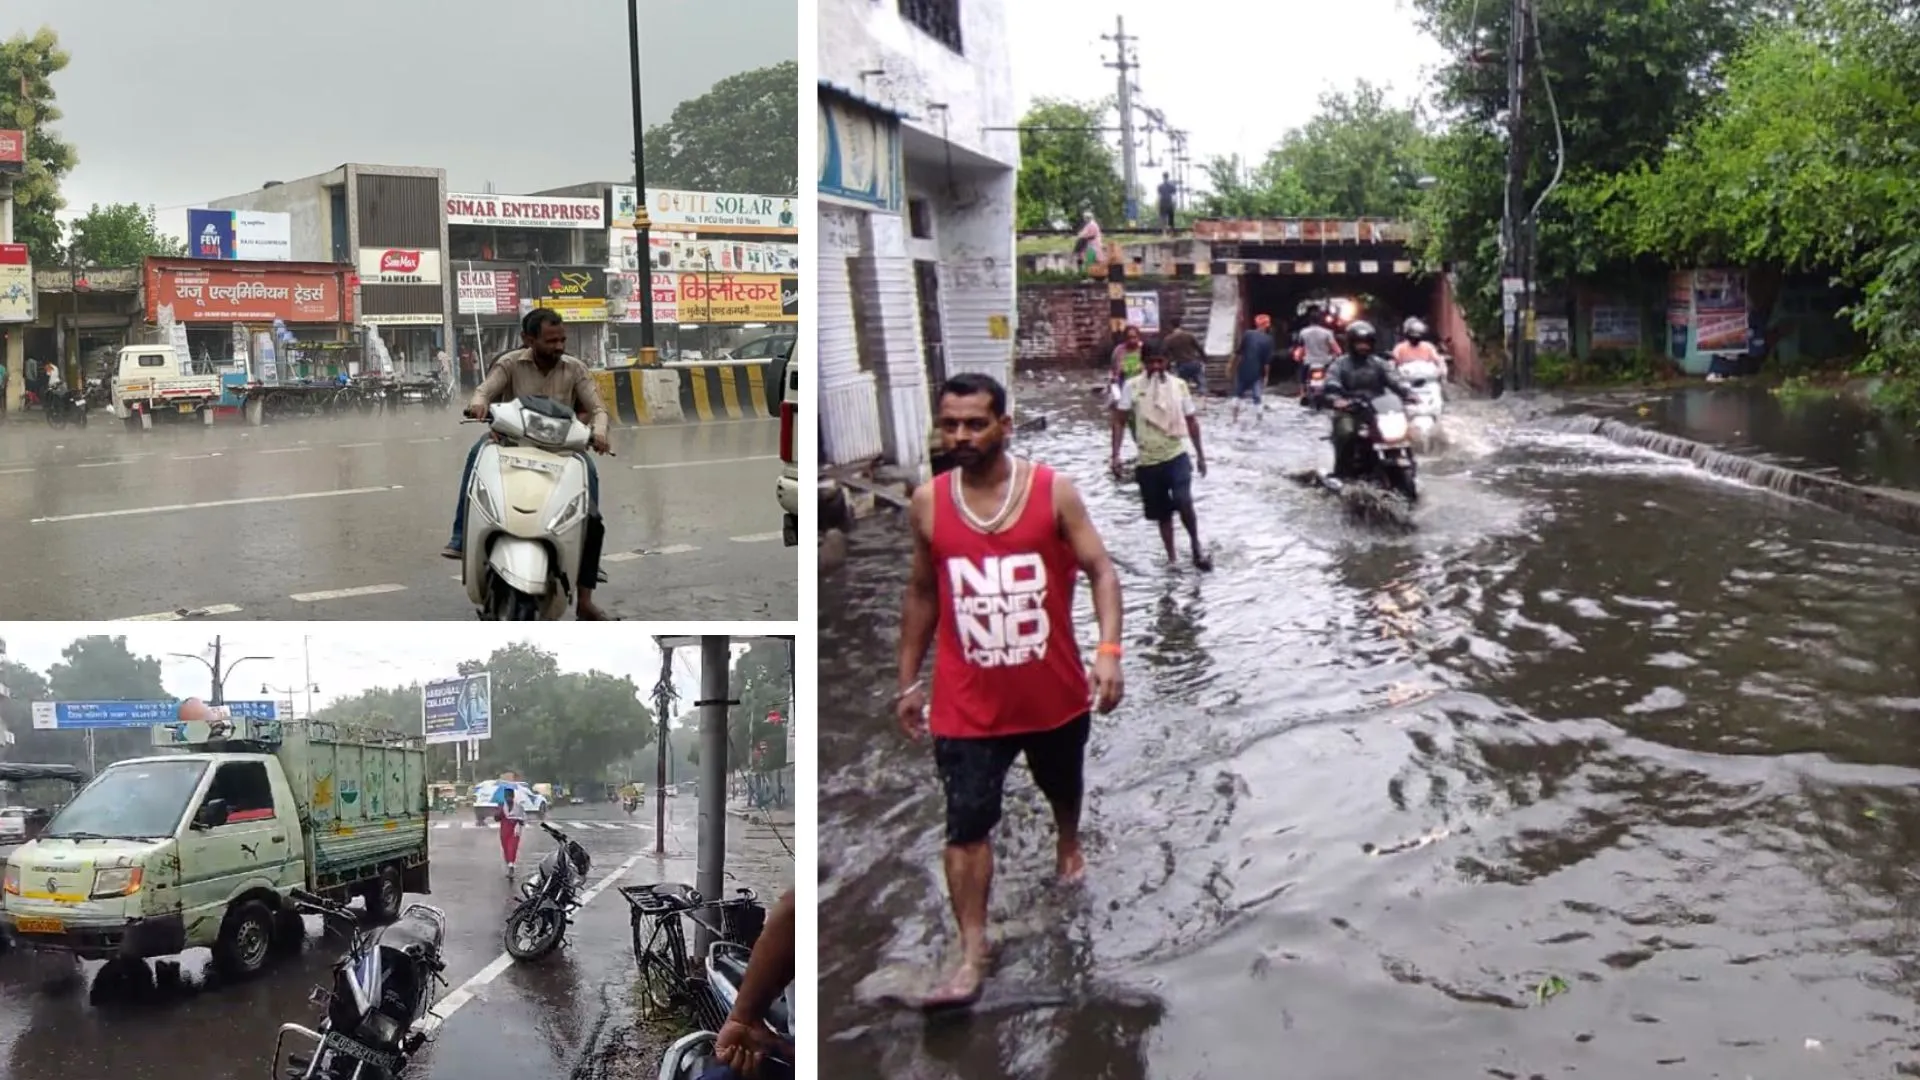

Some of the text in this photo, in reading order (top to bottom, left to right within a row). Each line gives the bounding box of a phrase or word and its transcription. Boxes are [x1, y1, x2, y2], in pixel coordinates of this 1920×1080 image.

[447, 200, 600, 220] SIMAR ENTERPRISES
[715, 196, 772, 215] SOLAR
[719, 216, 733, 224] from
[200, 235, 220, 245] FEVI
[381, 275, 422, 283] NAMKEEN
[176, 284, 205, 306] राजू
[294, 283, 324, 304] ट्रेडर्स
[947, 553, 1047, 596] NO
[954, 591, 1048, 616] MONEY
[956, 608, 1050, 650] NO
